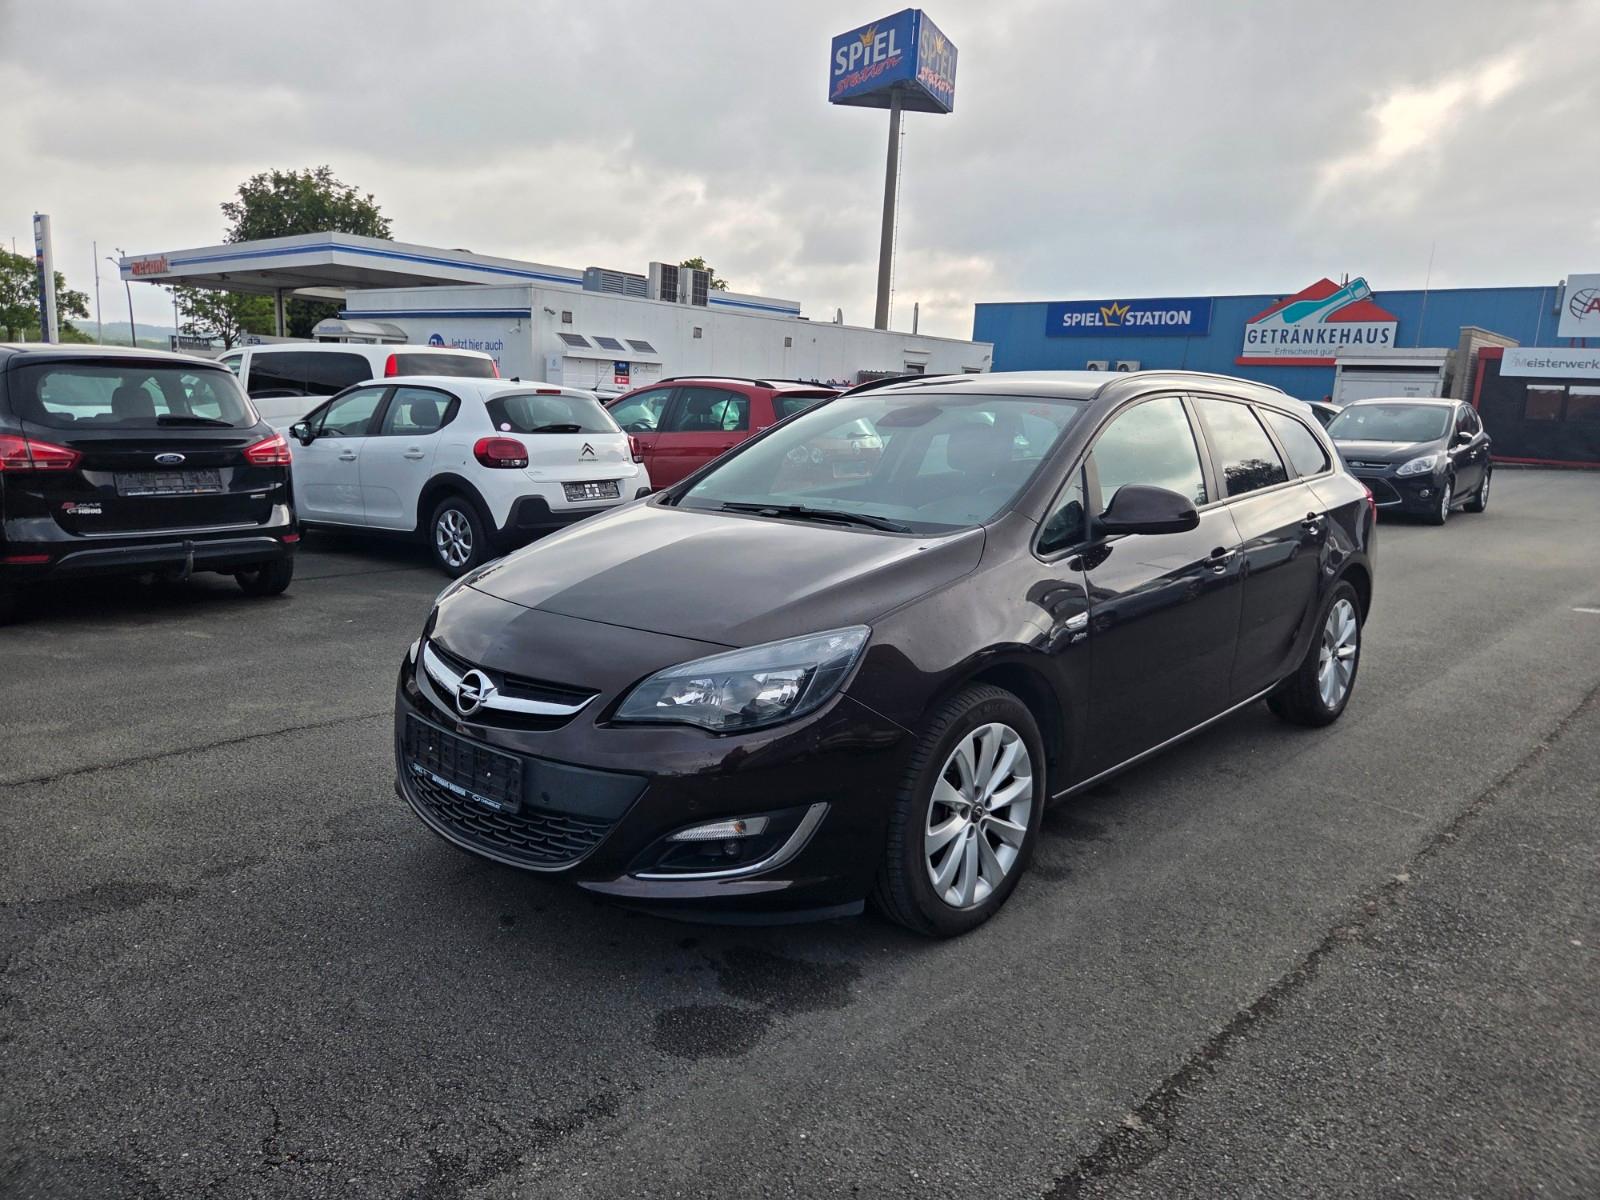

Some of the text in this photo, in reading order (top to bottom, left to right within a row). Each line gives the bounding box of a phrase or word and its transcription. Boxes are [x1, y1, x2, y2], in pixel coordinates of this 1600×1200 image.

[835, 29, 902, 76] SPIEL
[1063, 310, 1192, 327] SPIEL STATION
[1247, 324, 1391, 344] GETRÄNKEHAUS
[468, 339, 484, 350] hier
[485, 338, 504, 351] auch
